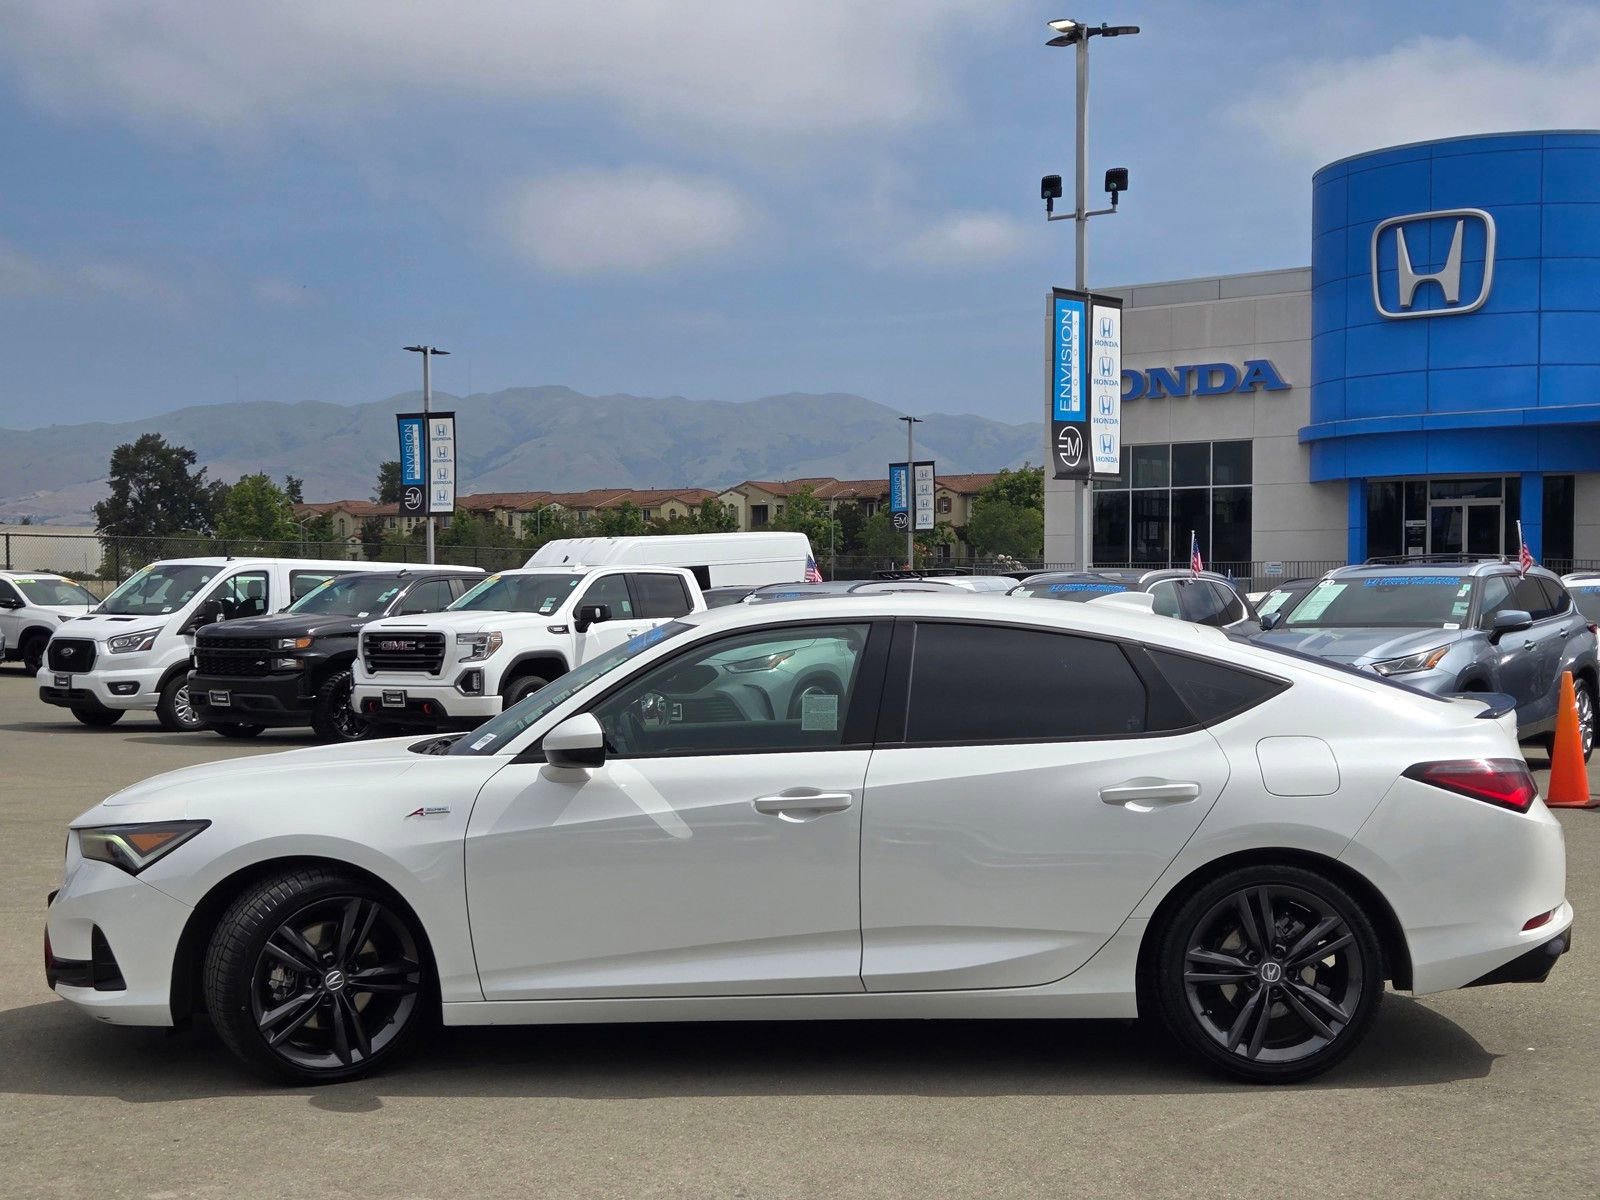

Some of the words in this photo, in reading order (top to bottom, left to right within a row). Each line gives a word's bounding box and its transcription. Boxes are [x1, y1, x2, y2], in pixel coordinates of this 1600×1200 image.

[1094, 339, 1119, 348] HONDA
[1060, 309, 1072, 411] ENVISION
[1093, 377, 1119, 386] HONDA
[1121, 359, 1291, 402] ONDA
[1093, 417, 1119, 425] HONDA
[404, 424, 415, 480] ENVISION
[1095, 455, 1118, 464] HONDA
[894, 469, 902, 509] ENVISION
[380, 640, 416, 651] GMC
